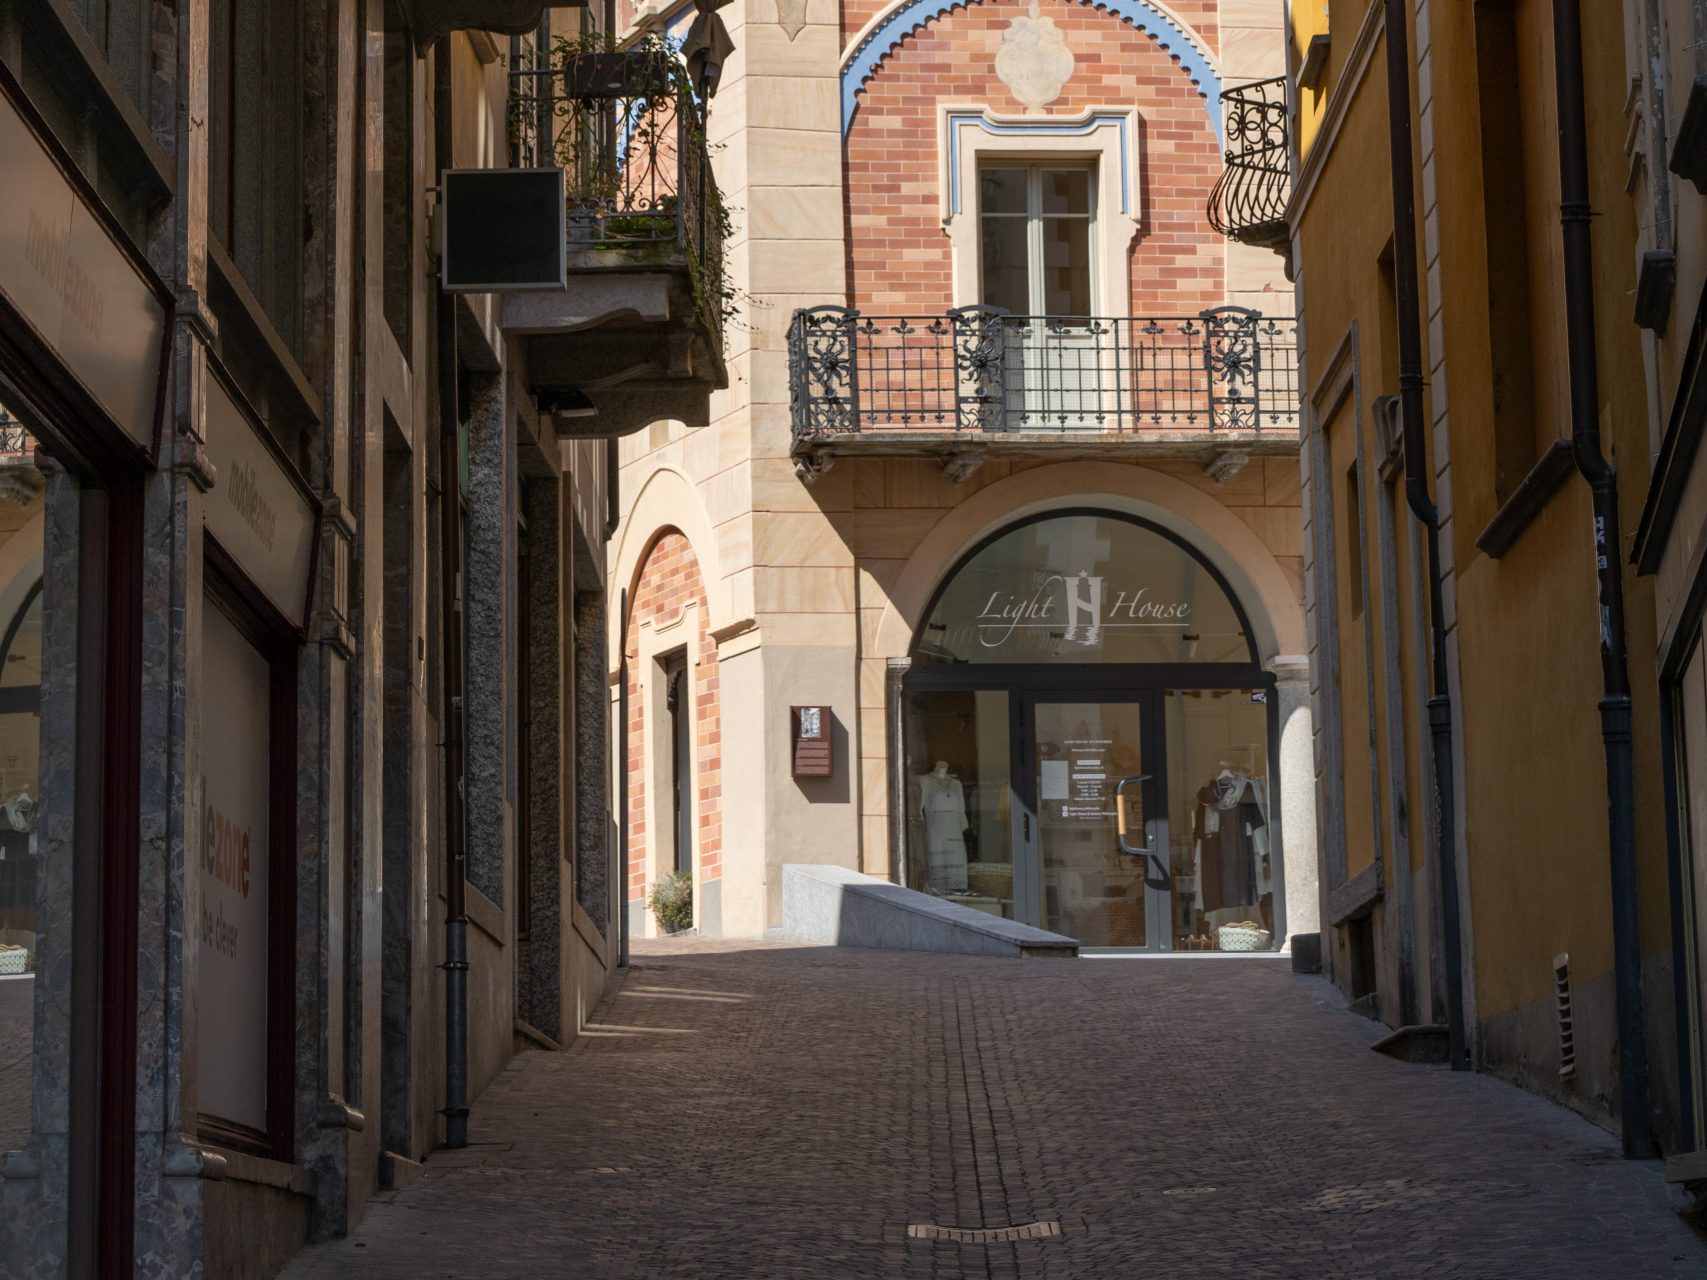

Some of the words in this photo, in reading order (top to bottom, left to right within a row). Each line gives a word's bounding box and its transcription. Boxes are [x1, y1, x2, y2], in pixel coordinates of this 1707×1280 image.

[26, 208, 104, 340] mobilezone
[228, 459, 276, 553] mobilezone
[977, 576, 1062, 647] Light
[1109, 587, 1191, 619] House
[200, 775, 250, 899] lezone
[202, 889, 213, 946] be
[215, 901, 238, 961] clever
